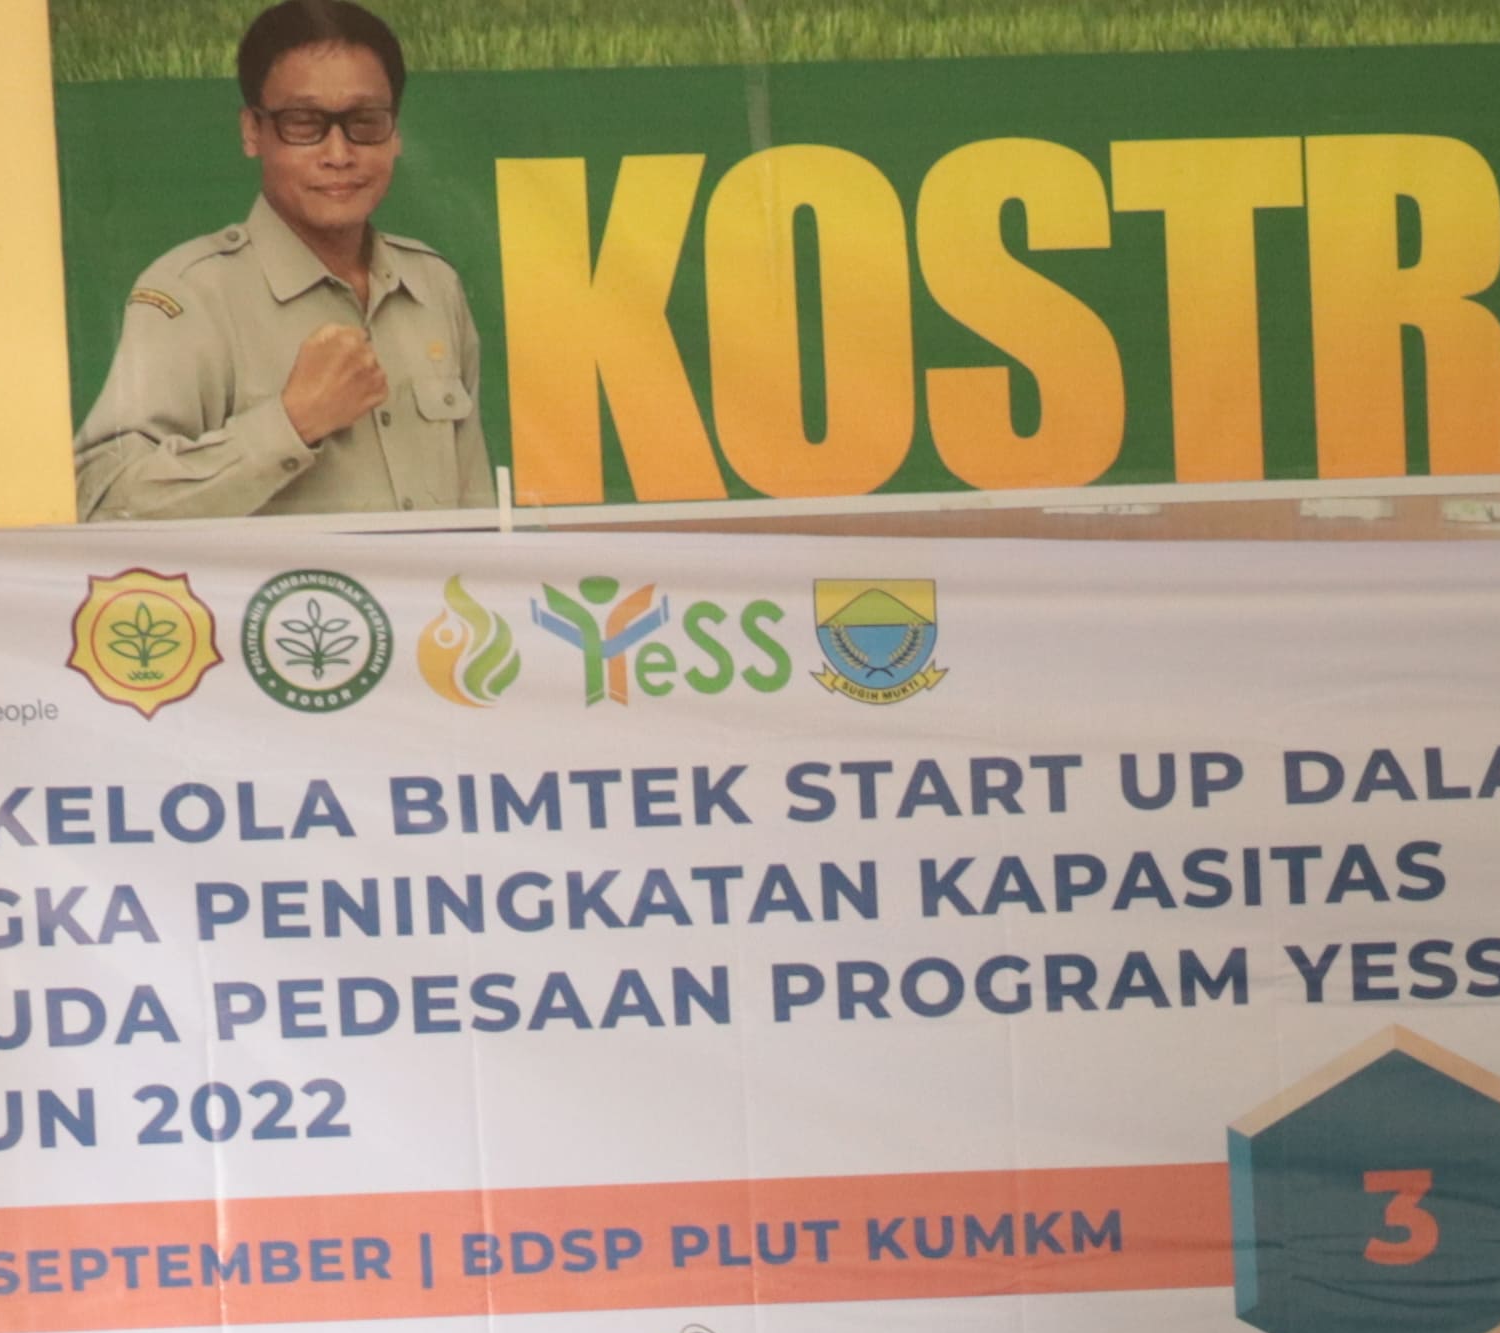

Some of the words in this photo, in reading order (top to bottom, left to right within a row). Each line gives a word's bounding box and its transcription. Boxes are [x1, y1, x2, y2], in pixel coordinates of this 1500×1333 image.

[264, 574, 364, 602] PEMBANGUNAN
[285, 689, 352, 707] BOGOR
[389, 765, 752, 837] BIMTEK
[785, 753, 1082, 822] START
[1118, 750, 1245, 811] UP
[195, 860, 881, 943] PENINGKATAN
[918, 840, 1448, 918] KAPASITAS
[212, 966, 733, 1042] PEDESAAN
[772, 946, 1252, 1024] PROGRAM
[132, 1078, 353, 1147] 2022
[462, 1225, 644, 1279] BDSP
[670, 1218, 840, 1269] PLUT
[866, 1207, 1124, 1262] KUMKM
[1360, 1167, 1442, 1267] 3
